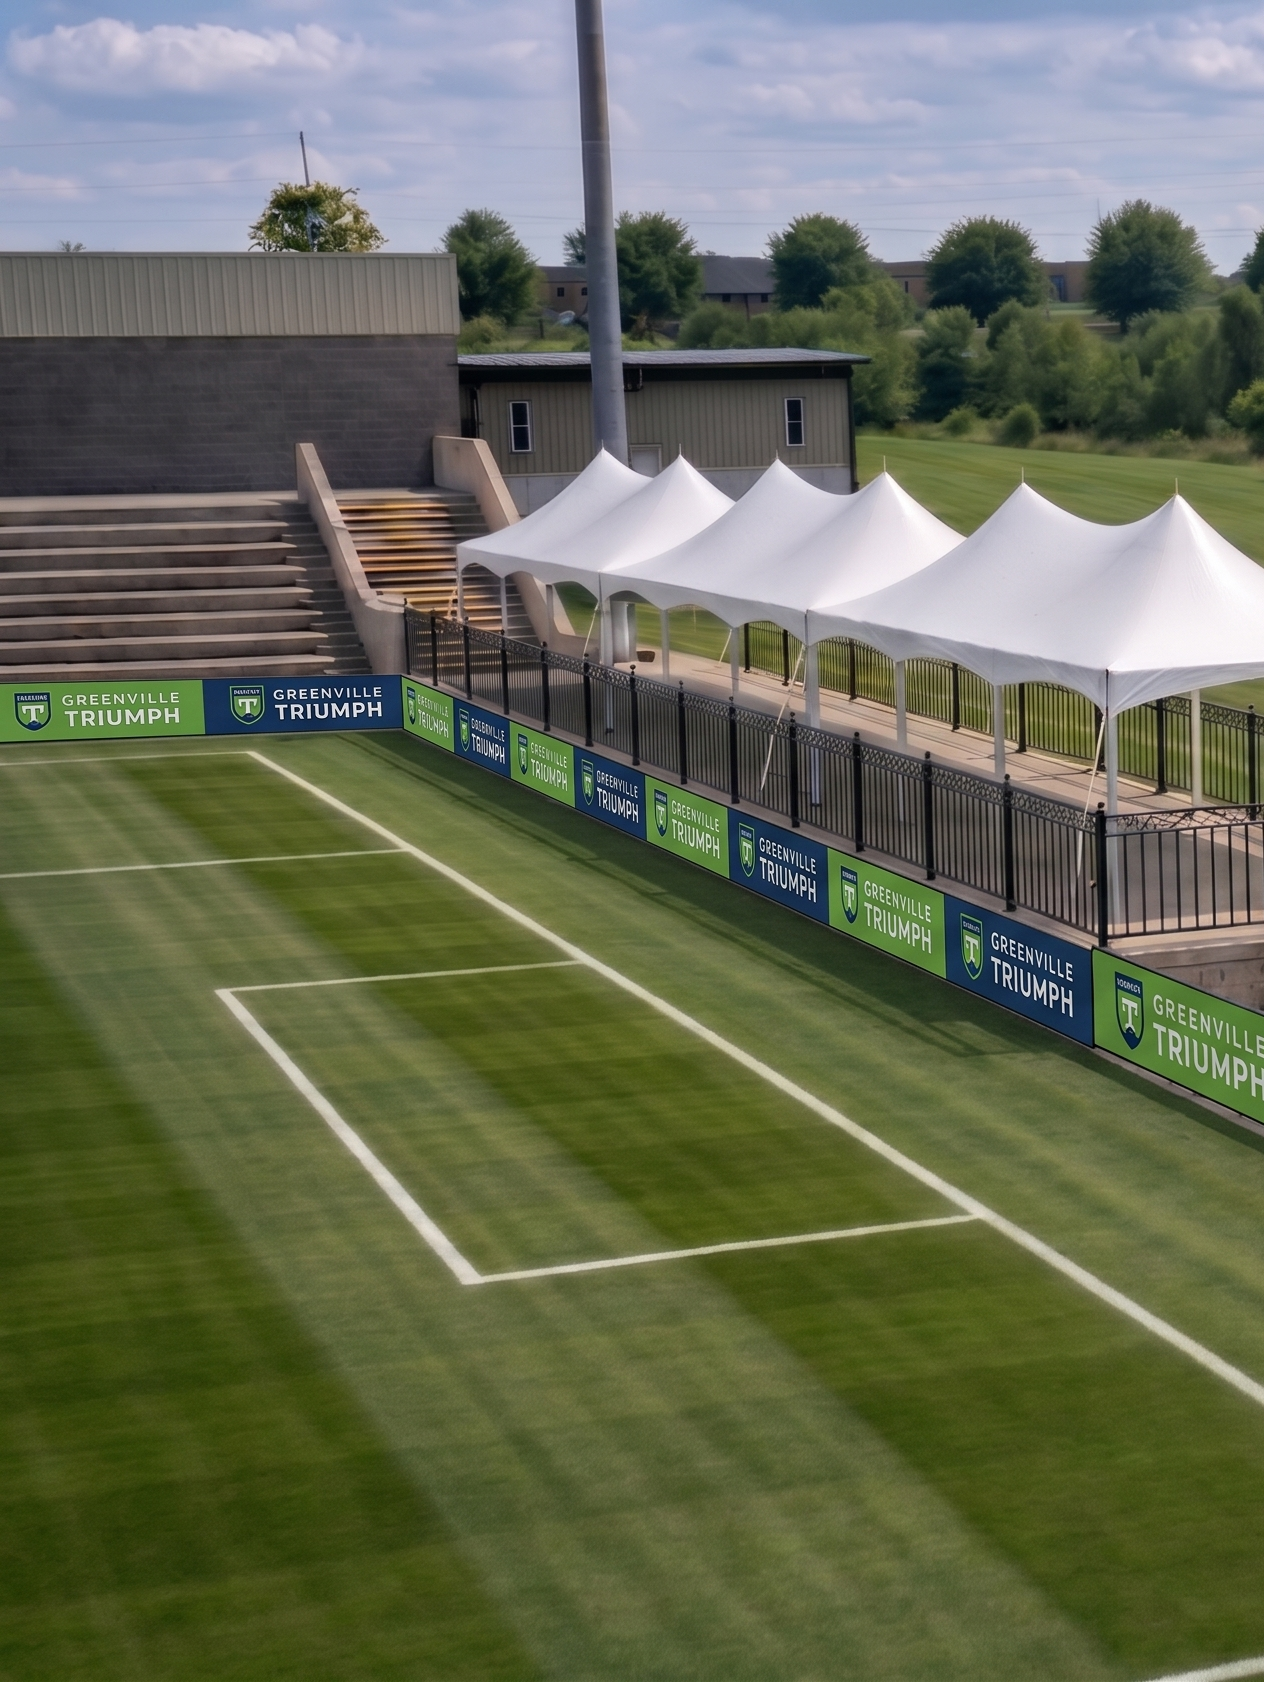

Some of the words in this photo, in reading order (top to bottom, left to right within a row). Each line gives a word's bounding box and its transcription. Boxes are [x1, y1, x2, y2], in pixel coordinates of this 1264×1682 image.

[62, 692, 180, 706] GREENVILLE
[273, 686, 382, 700] GREENVILLE
[275, 701, 383, 720] TRIUMPH
[64, 707, 180, 727] TRIUMPH
[596, 787, 639, 823] TRIUMPH
[671, 800, 720, 833] GREENVILLE
[671, 818, 720, 859] TRIUMPH
[759, 837, 817, 875] GREENVILLE
[759, 856, 817, 903] TRIUMPH
[864, 880, 932, 924] GREENVILLE
[864, 902, 932, 954] TRIUMPH
[990, 931, 1074, 983] GREENVILLE
[990, 956, 1074, 1018] TRIUMPH
